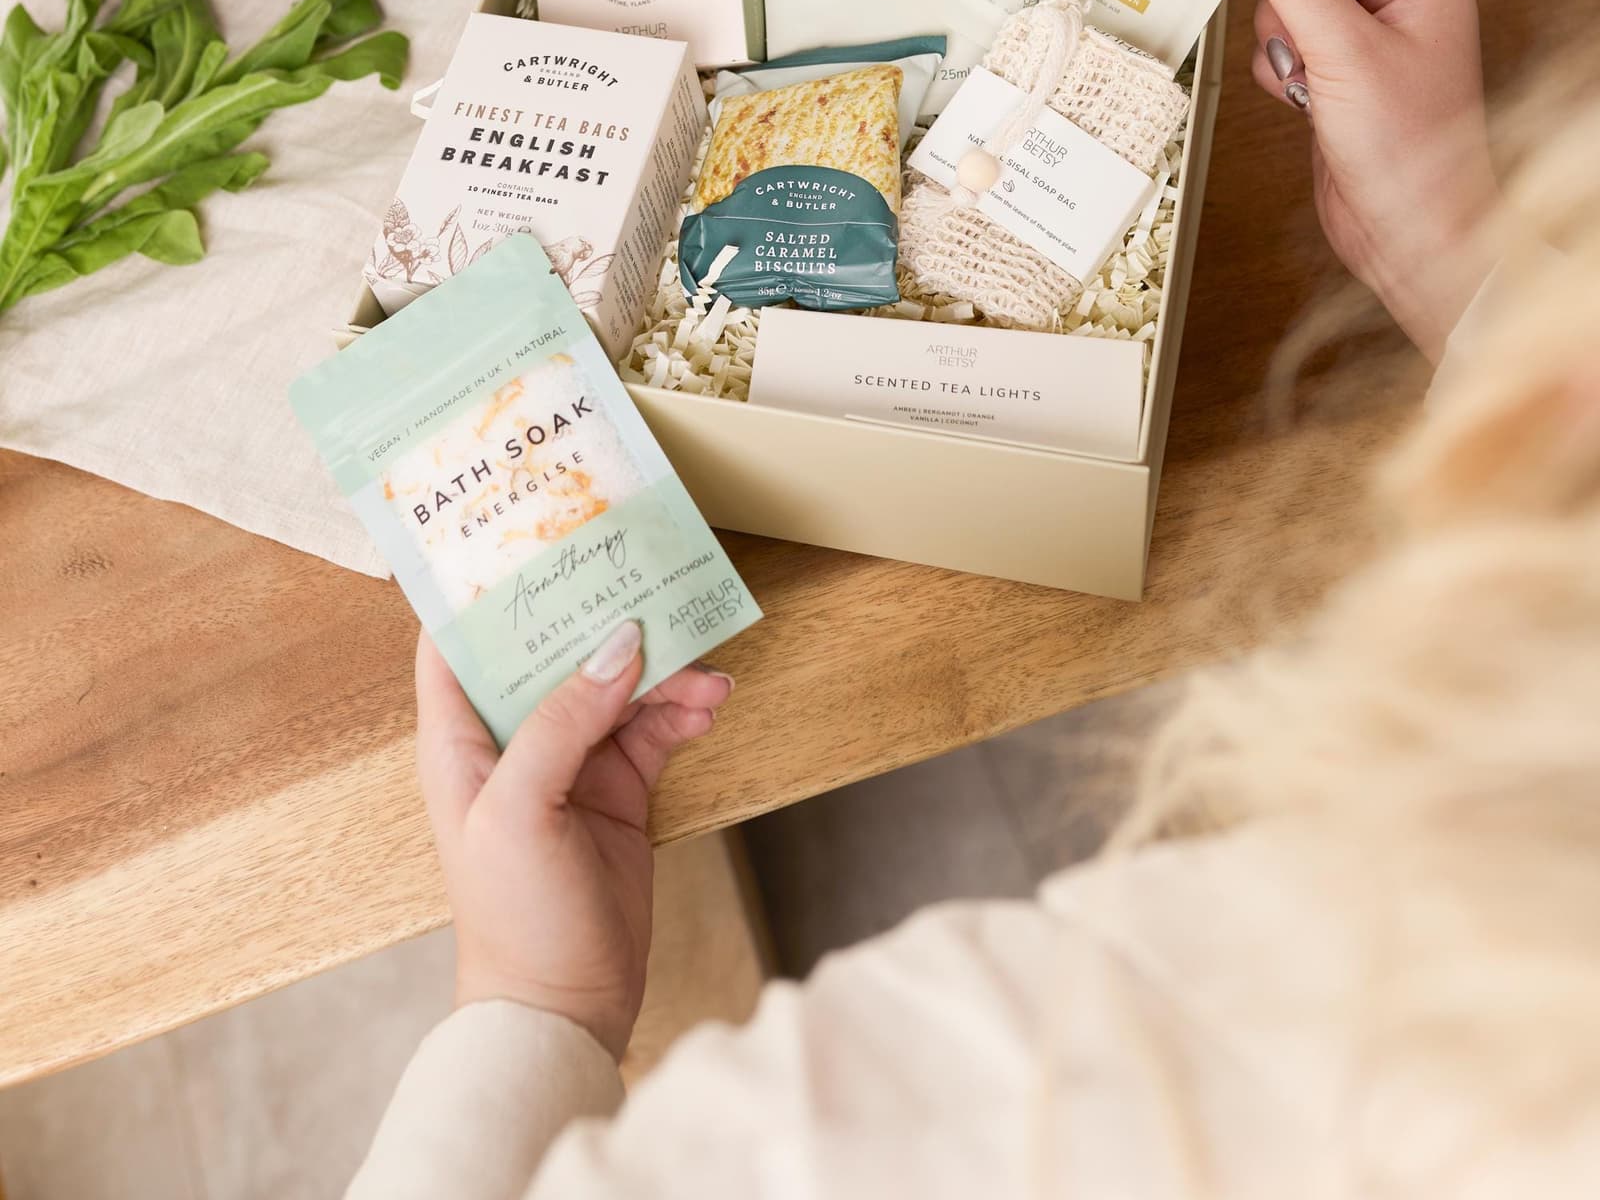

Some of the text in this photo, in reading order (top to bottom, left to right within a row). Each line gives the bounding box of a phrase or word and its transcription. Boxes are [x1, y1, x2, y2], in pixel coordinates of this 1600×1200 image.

[503, 56, 618, 88] CARTWRIGHT
[524, 75, 590, 92] & BUTLER
[540, 68, 580, 78] ENGLAND
[940, 67, 970, 81] 25ml
[454, 102, 631, 142] FINEST TEA BAGS
[470, 127, 596, 159] ENGLISH
[1022, 139, 1062, 168] BETSY
[1026, 128, 1069, 161] RTHUR
[440, 146, 609, 186] BREAKFAST
[481, 187, 513, 198] FINEST
[516, 193, 532, 201] TEA
[535, 196, 559, 205] BAGS
[496, 182, 535, 193] CONTAINS
[755, 180, 856, 201] CARTWRIGHT
[789, 192, 823, 200] ENGLAND
[1006, 158, 1031, 179] SISAL
[1032, 176, 1058, 195] SOAP
[1057, 194, 1078, 210] BAG
[476, 208, 534, 223] NET WEIGHT
[771, 198, 837, 210] & BUTLER
[765, 231, 831, 245] SALTED
[755, 245, 837, 259] CARAMEL
[754, 261, 836, 274] BISCUITS
[926, 344, 978, 358] ARTHUR
[938, 355, 976, 368] BETSY
[367, 326, 567, 462] VEGAN HANDMADE IN UK NATURAL
[854, 374, 1041, 401] SCENTED TEA LIGHTS
[894, 406, 995, 421] AMBER BERGAMOT ORANGE
[910, 414, 979, 427] VANILLA COCONUT
[413, 395, 592, 525] BATH SOAK
[461, 451, 583, 538] ENERGISE
[503, 528, 628, 631] Aromatherapy
[623, 587, 655, 611] YLANG
[661, 552, 715, 588] PATCHOULI
[525, 567, 643, 654] BATH SALTS
[668, 577, 738, 631] ARTHUR
[693, 593, 745, 635] BETSY
